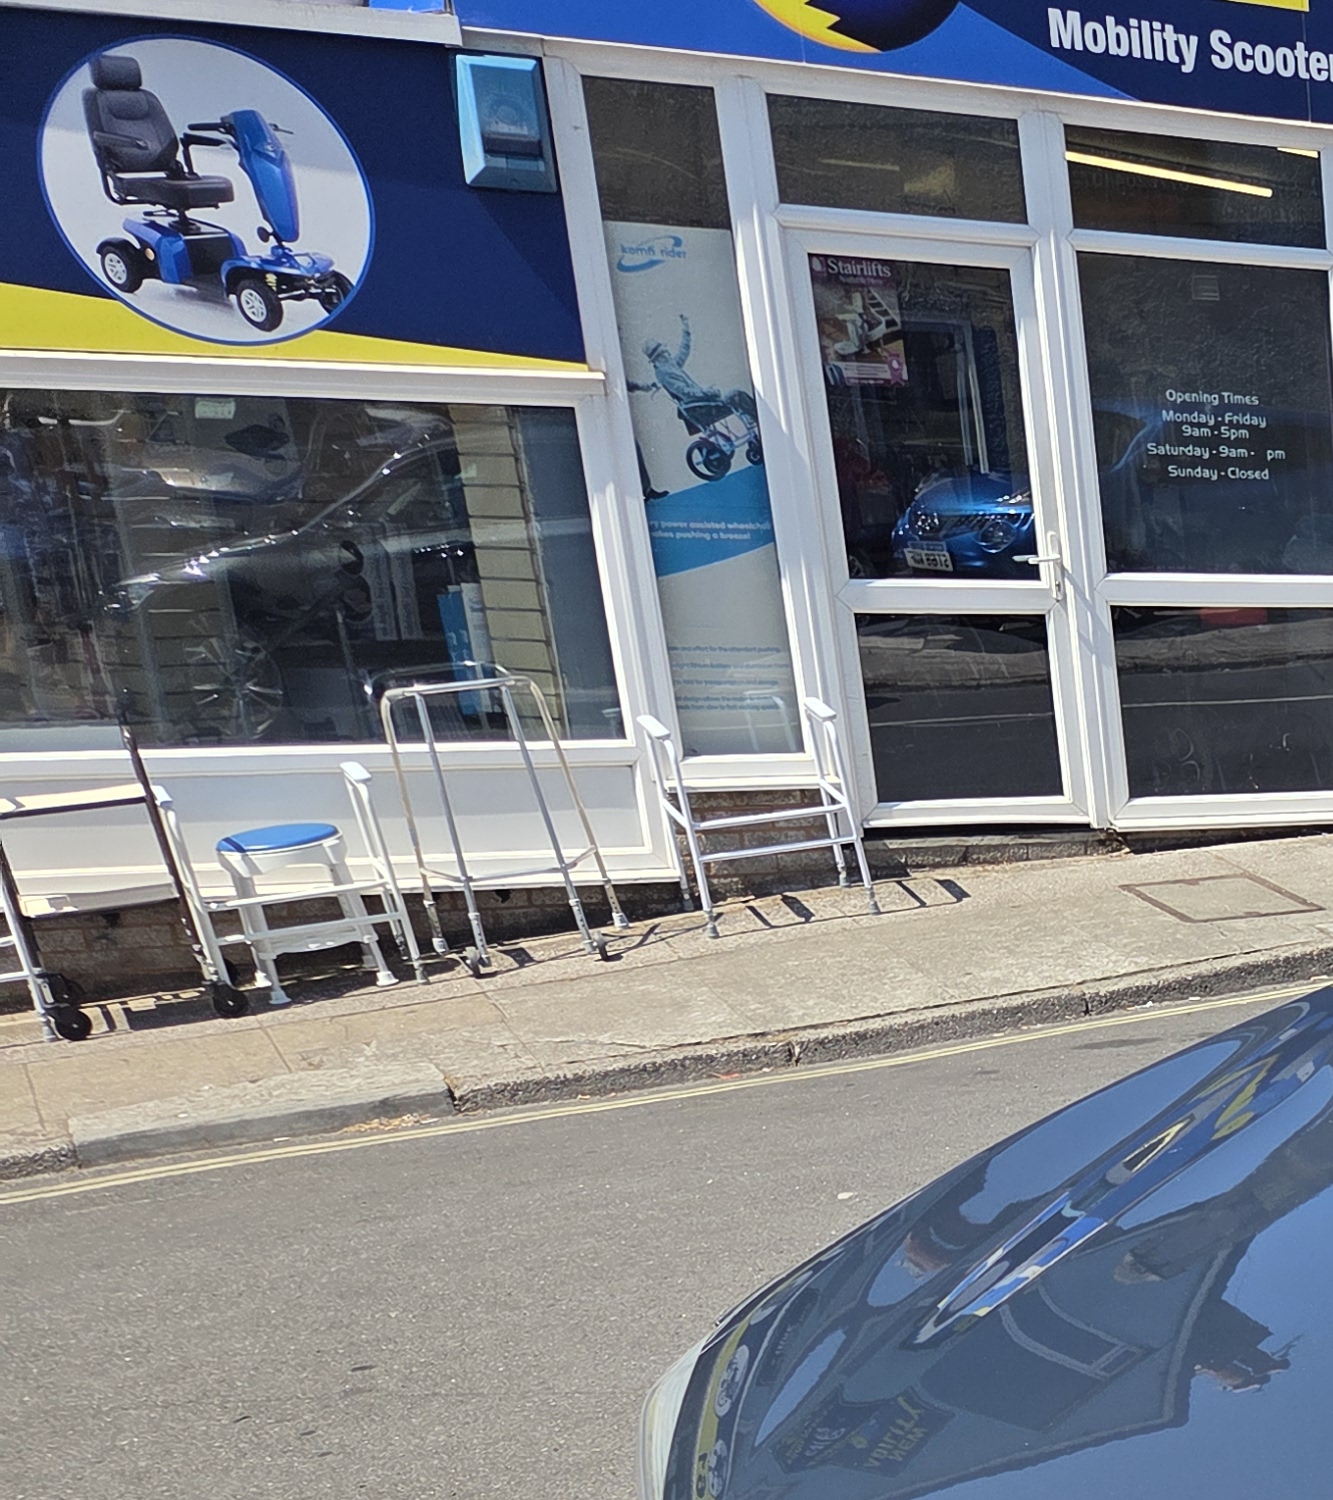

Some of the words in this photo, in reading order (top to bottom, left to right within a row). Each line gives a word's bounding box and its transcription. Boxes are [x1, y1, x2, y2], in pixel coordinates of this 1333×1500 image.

[1048, 8, 1198, 73] Mobility
[827, 257, 892, 278] Stairlifts
[1166, 389, 1219, 405] Opening
[1221, 391, 1259, 405] Times
[1162, 410, 1215, 426] Monday
[1225, 412, 1267, 428] Friday
[1182, 425, 1211, 437] 9am
[1220, 426, 1249, 440] 5pm
[1147, 443, 1210, 459] Saturday
[1218, 446, 1248, 458] 9am
[1266, 450, 1286, 461] pm
[1168, 465, 1218, 480] Sunday
[1227, 467, 1270, 480] Closed
